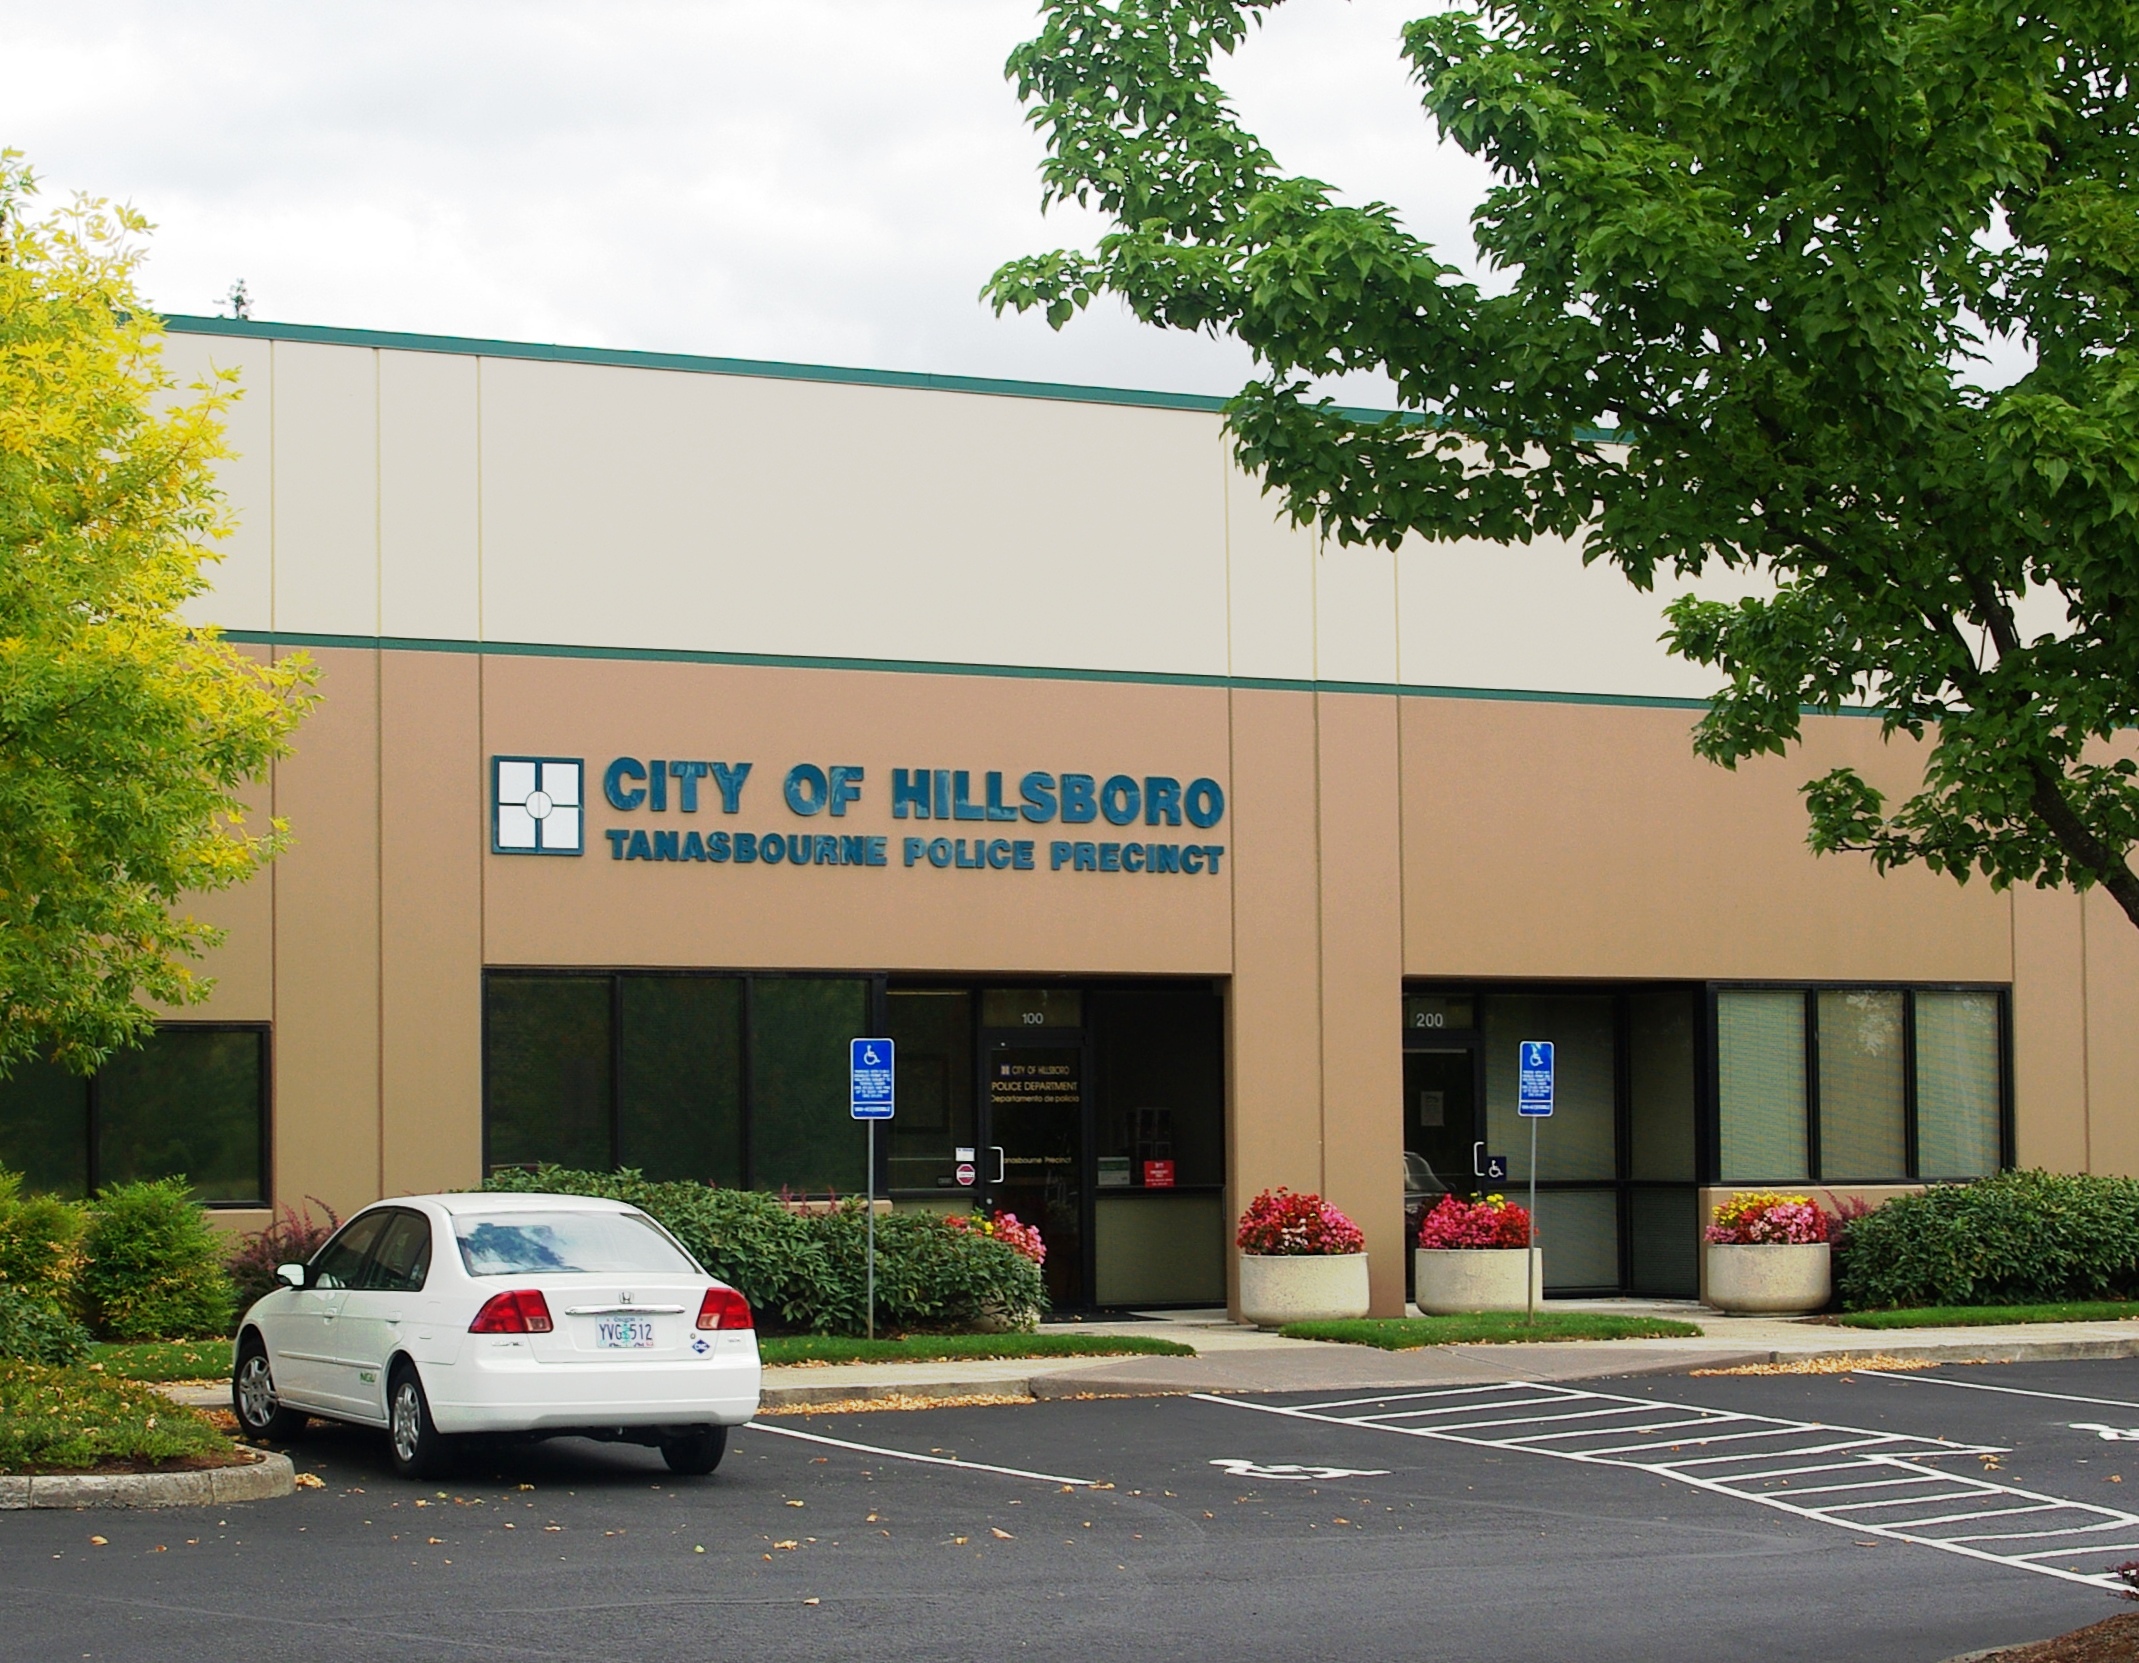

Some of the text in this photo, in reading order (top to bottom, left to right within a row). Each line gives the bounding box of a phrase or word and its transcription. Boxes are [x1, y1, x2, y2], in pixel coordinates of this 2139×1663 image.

[604, 757, 1225, 828] CITY OF HILLSBORO
[606, 829, 1224, 874] TANASBOURNE POLICE PRECINCT
[1022, 1012, 1044, 1024] 100
[1416, 1013, 1443, 1027] 200
[1011, 1065, 1026, 1075] CITY
[1027, 1065, 1037, 1075] OF
[991, 1081, 1078, 1091] POLICE DEPARTMENT
[1002, 1156, 1042, 1164] anasbourne
[599, 1324, 653, 1340] YVG 512
